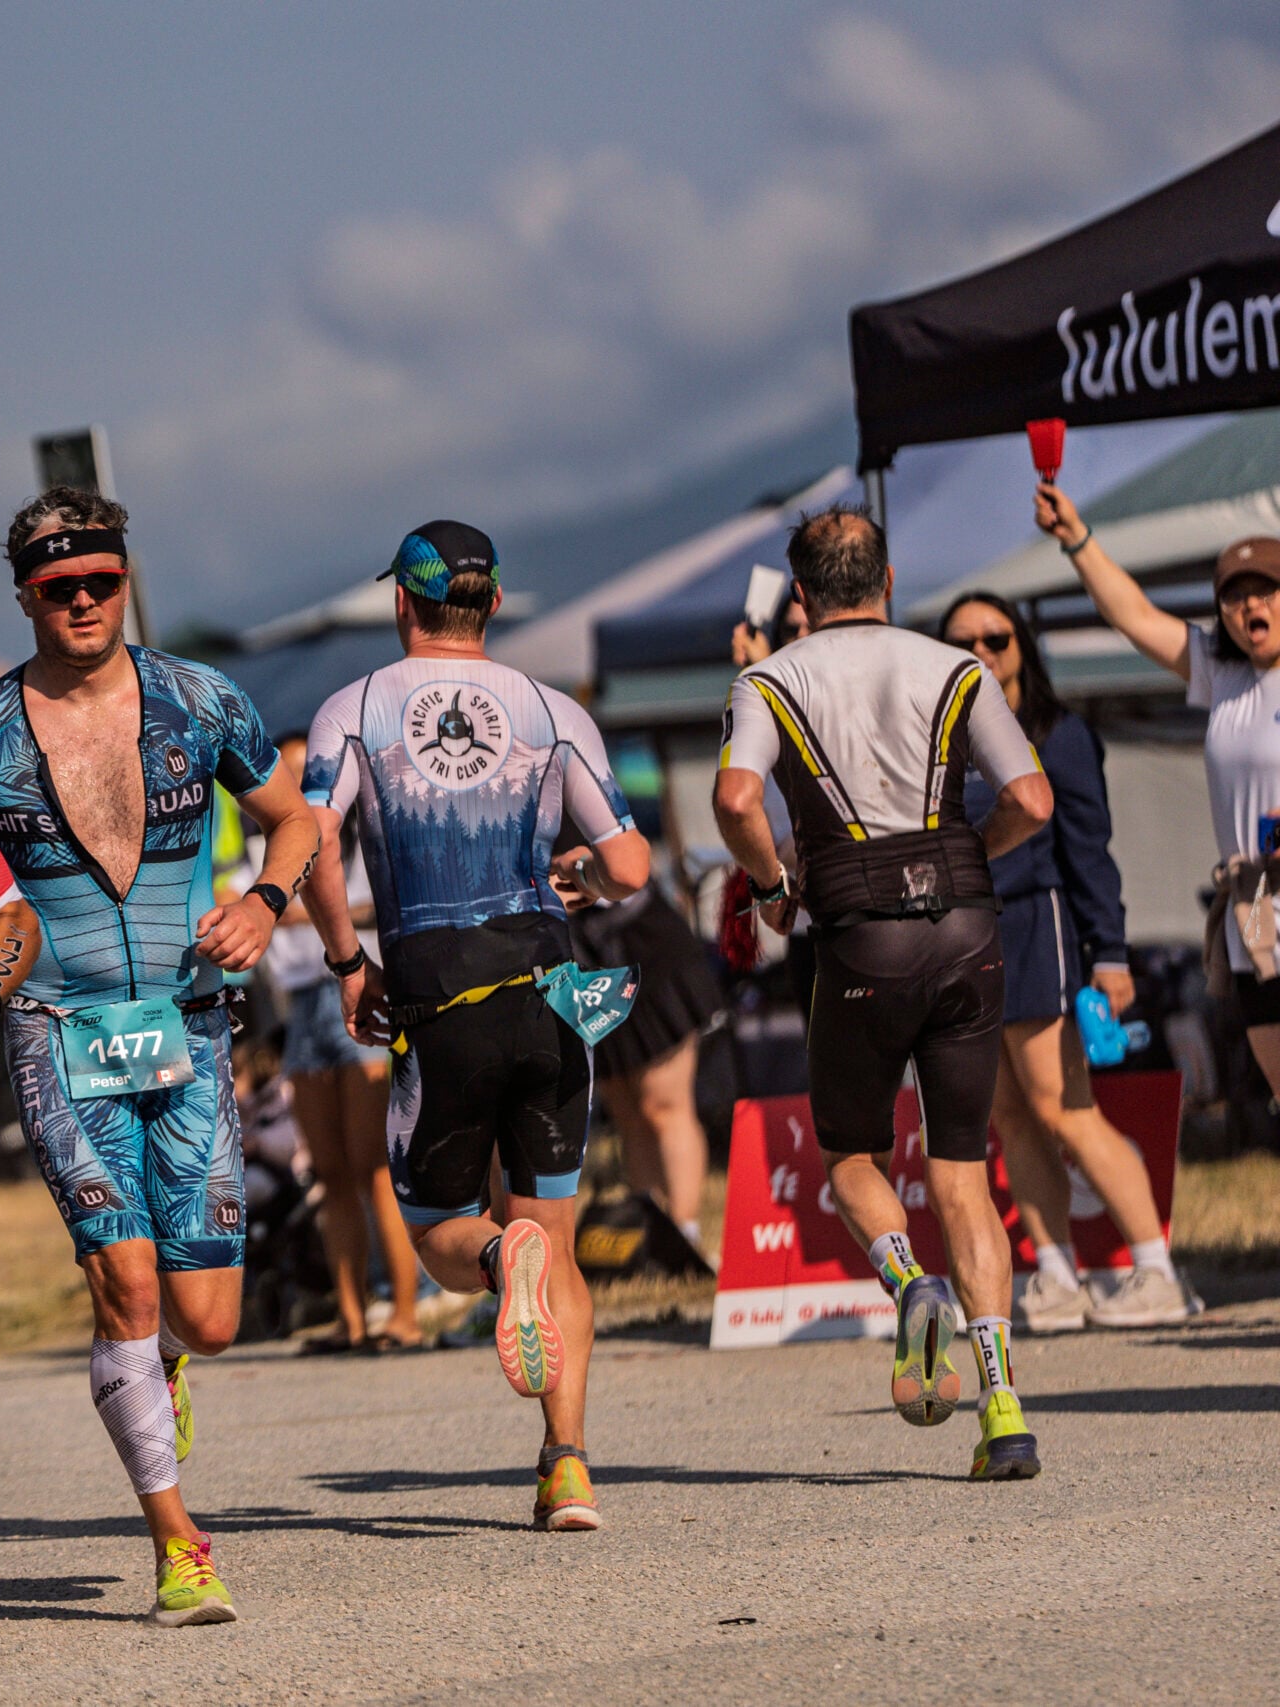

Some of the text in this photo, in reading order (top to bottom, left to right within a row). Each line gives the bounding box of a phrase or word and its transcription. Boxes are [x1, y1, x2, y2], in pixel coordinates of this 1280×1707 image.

[411, 690, 502, 740] PACIFIC SPIRIT
[429, 755, 488, 781] TRI CLUB
[87, 1029, 164, 1064] 1477
[89, 1073, 132, 1089] Peter
[19, 1063, 71, 1220] HIT SQUAD
